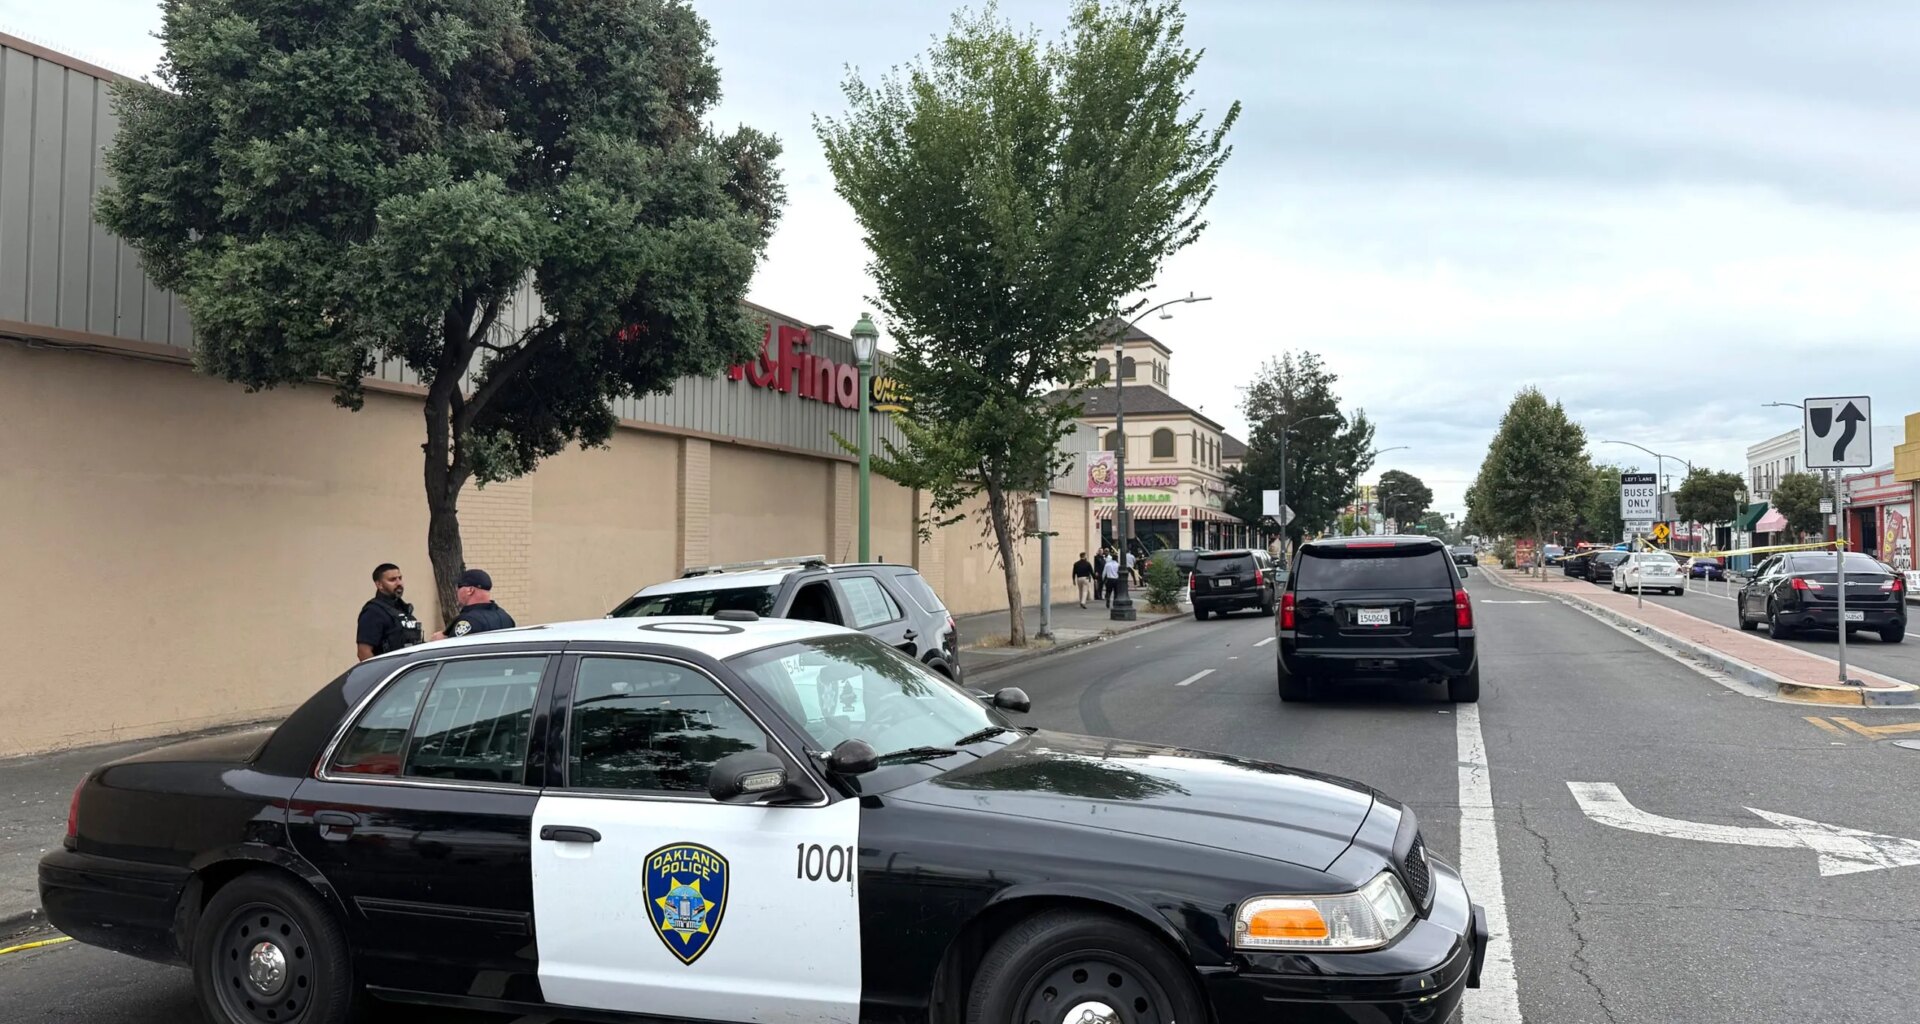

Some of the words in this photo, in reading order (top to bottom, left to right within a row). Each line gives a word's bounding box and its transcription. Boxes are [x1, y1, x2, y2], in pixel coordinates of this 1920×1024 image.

[1136, 493, 1171, 503] PARLOR
[1624, 488, 1654, 497] BUSES
[1628, 499, 1650, 507] ONLY
[653, 850, 720, 875] OAKLAND
[797, 842, 854, 883] 1001
[660, 861, 711, 882] POLICE
